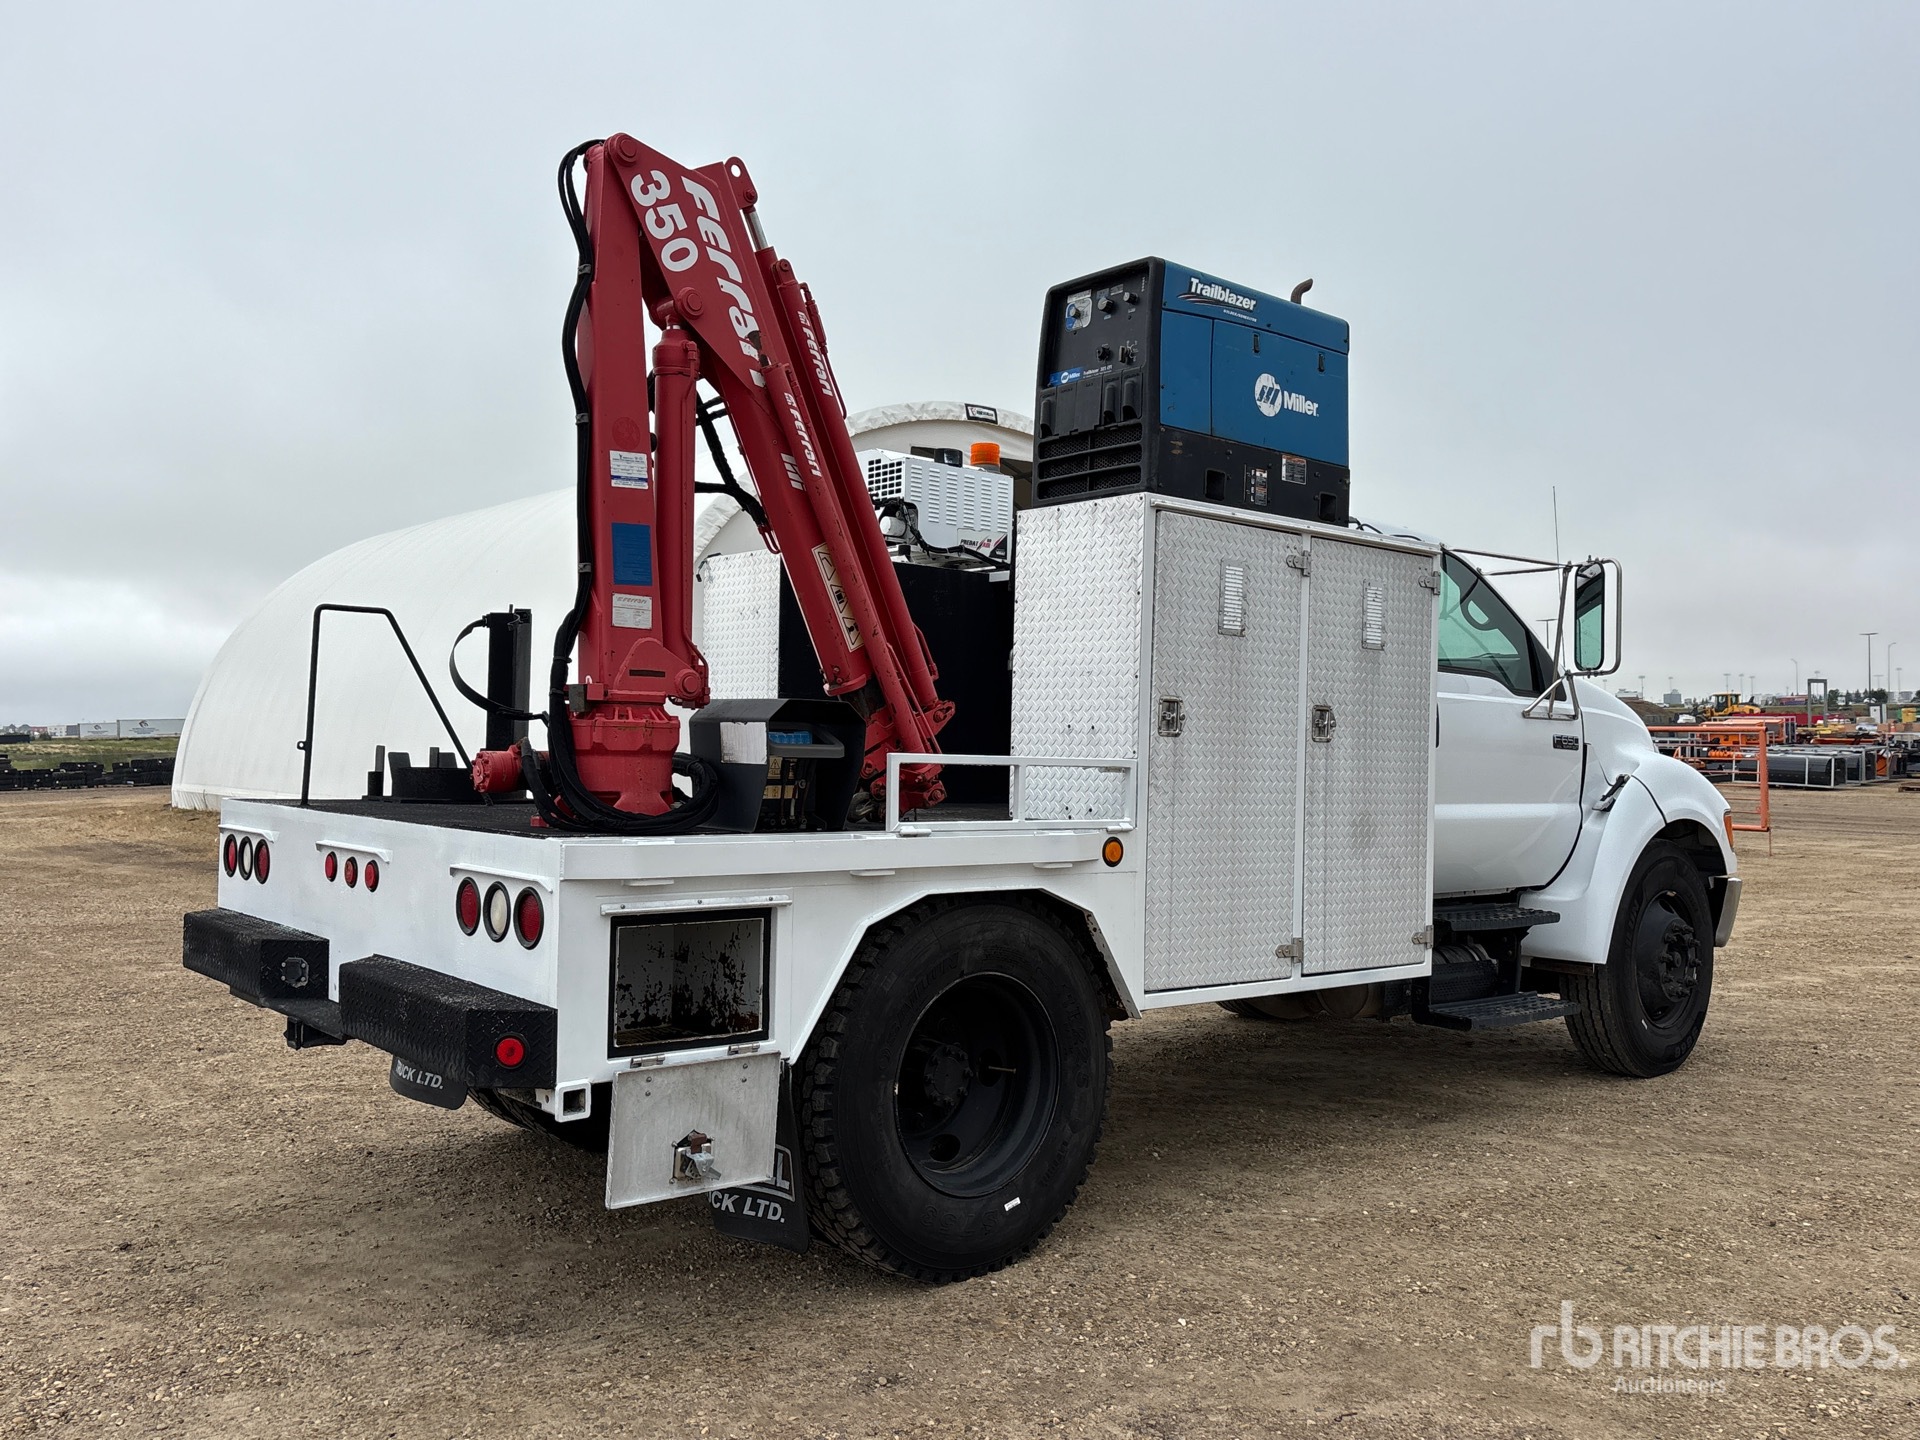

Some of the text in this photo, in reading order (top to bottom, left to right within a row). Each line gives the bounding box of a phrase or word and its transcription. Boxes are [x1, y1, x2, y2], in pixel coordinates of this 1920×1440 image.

[630, 169, 699, 273] 350
[1190, 277, 1257, 311] Trailblazer
[802, 328, 834, 397] Ferrari
[1283, 390, 1319, 417] Miller
[790, 409, 823, 478] Ferrari
[416, 1070, 444, 1090] LTD.
[742, 1196, 786, 1224] LTD.
